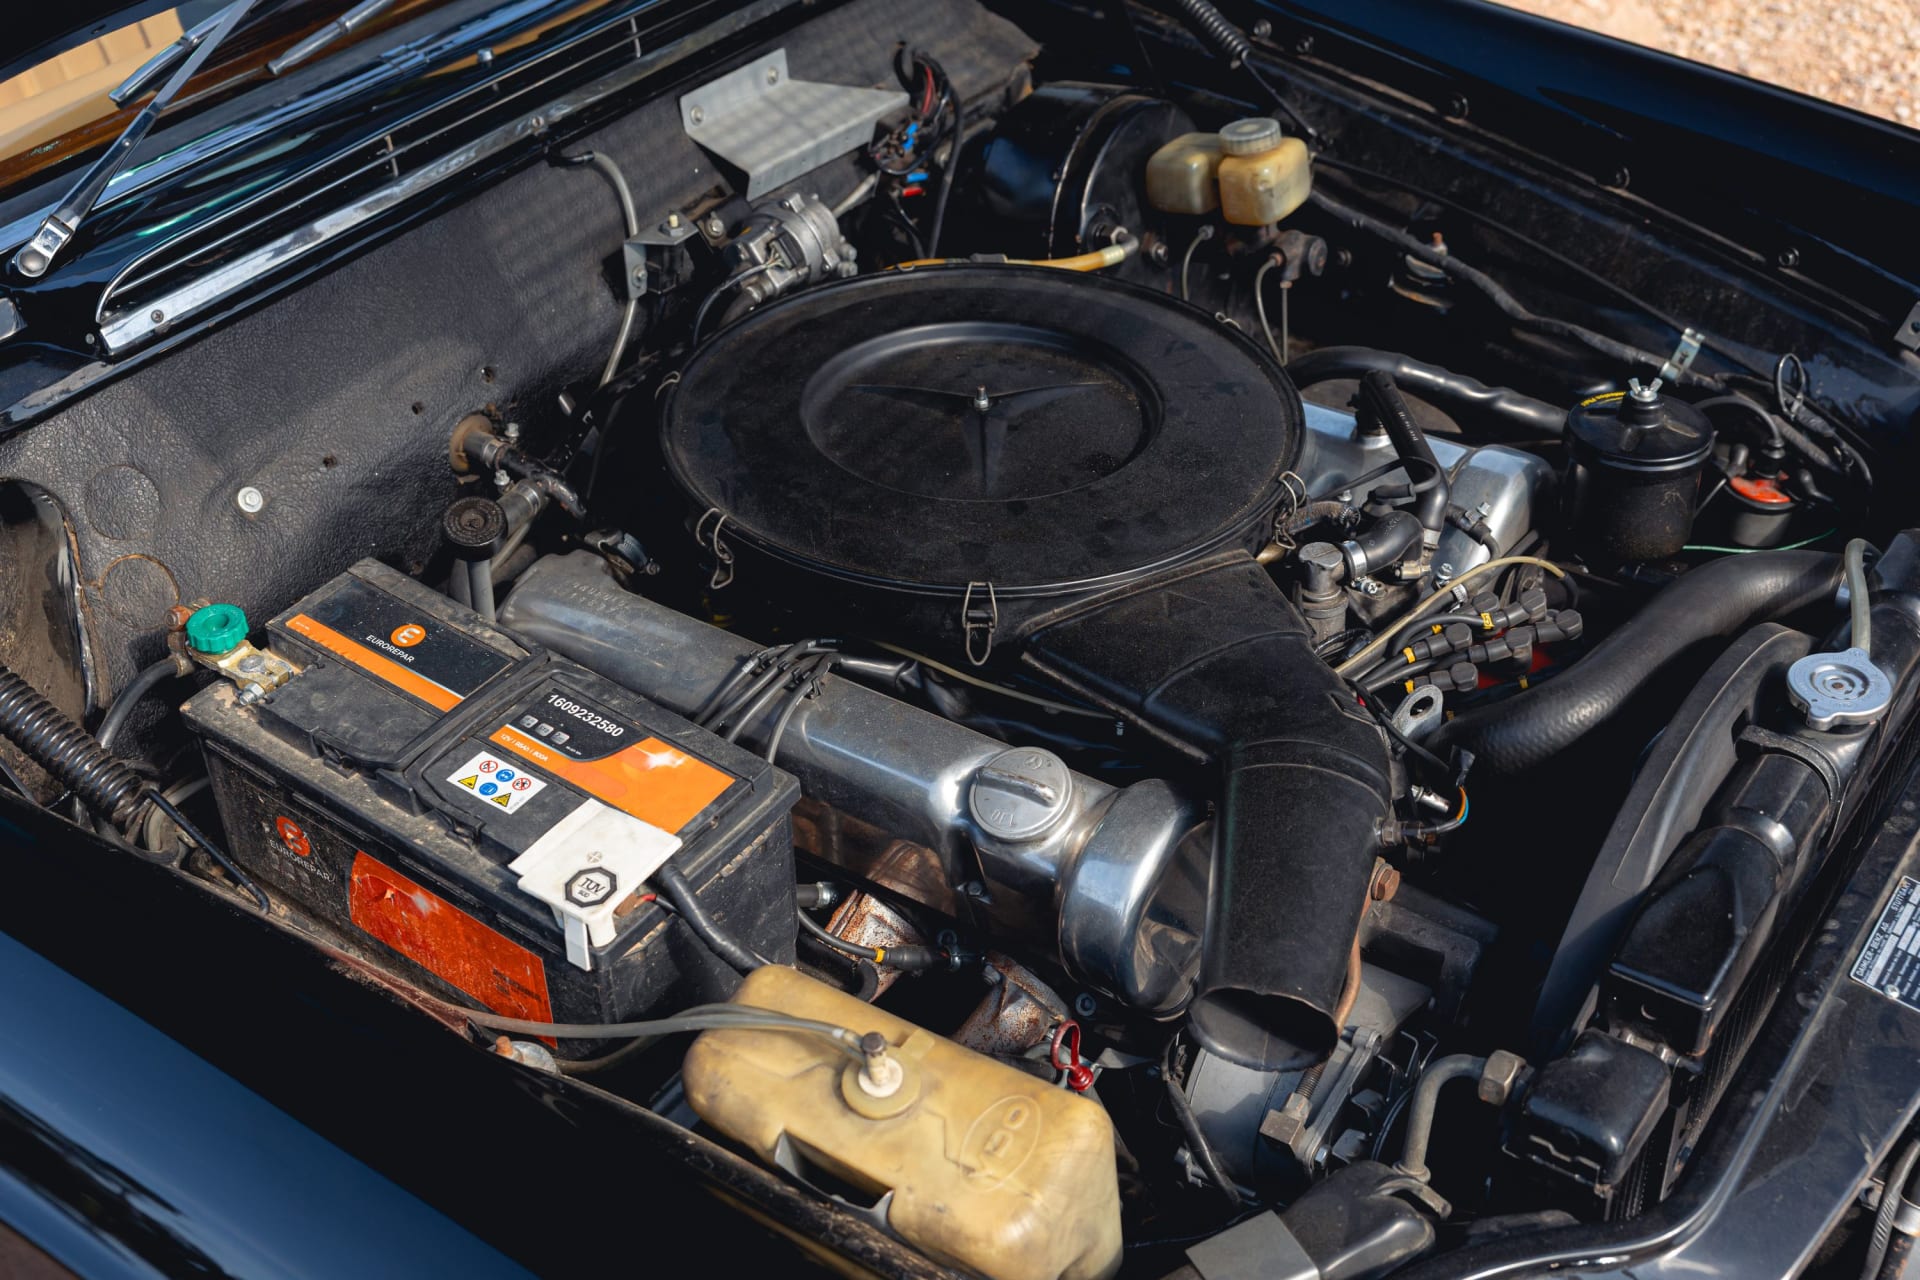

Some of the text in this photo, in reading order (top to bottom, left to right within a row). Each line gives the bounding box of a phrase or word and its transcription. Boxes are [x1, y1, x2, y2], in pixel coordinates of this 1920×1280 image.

[366, 634, 415, 663] EUROREPAR
[548, 694, 625, 737] 1609232580
[269, 839, 331, 883] EUROREPAR
